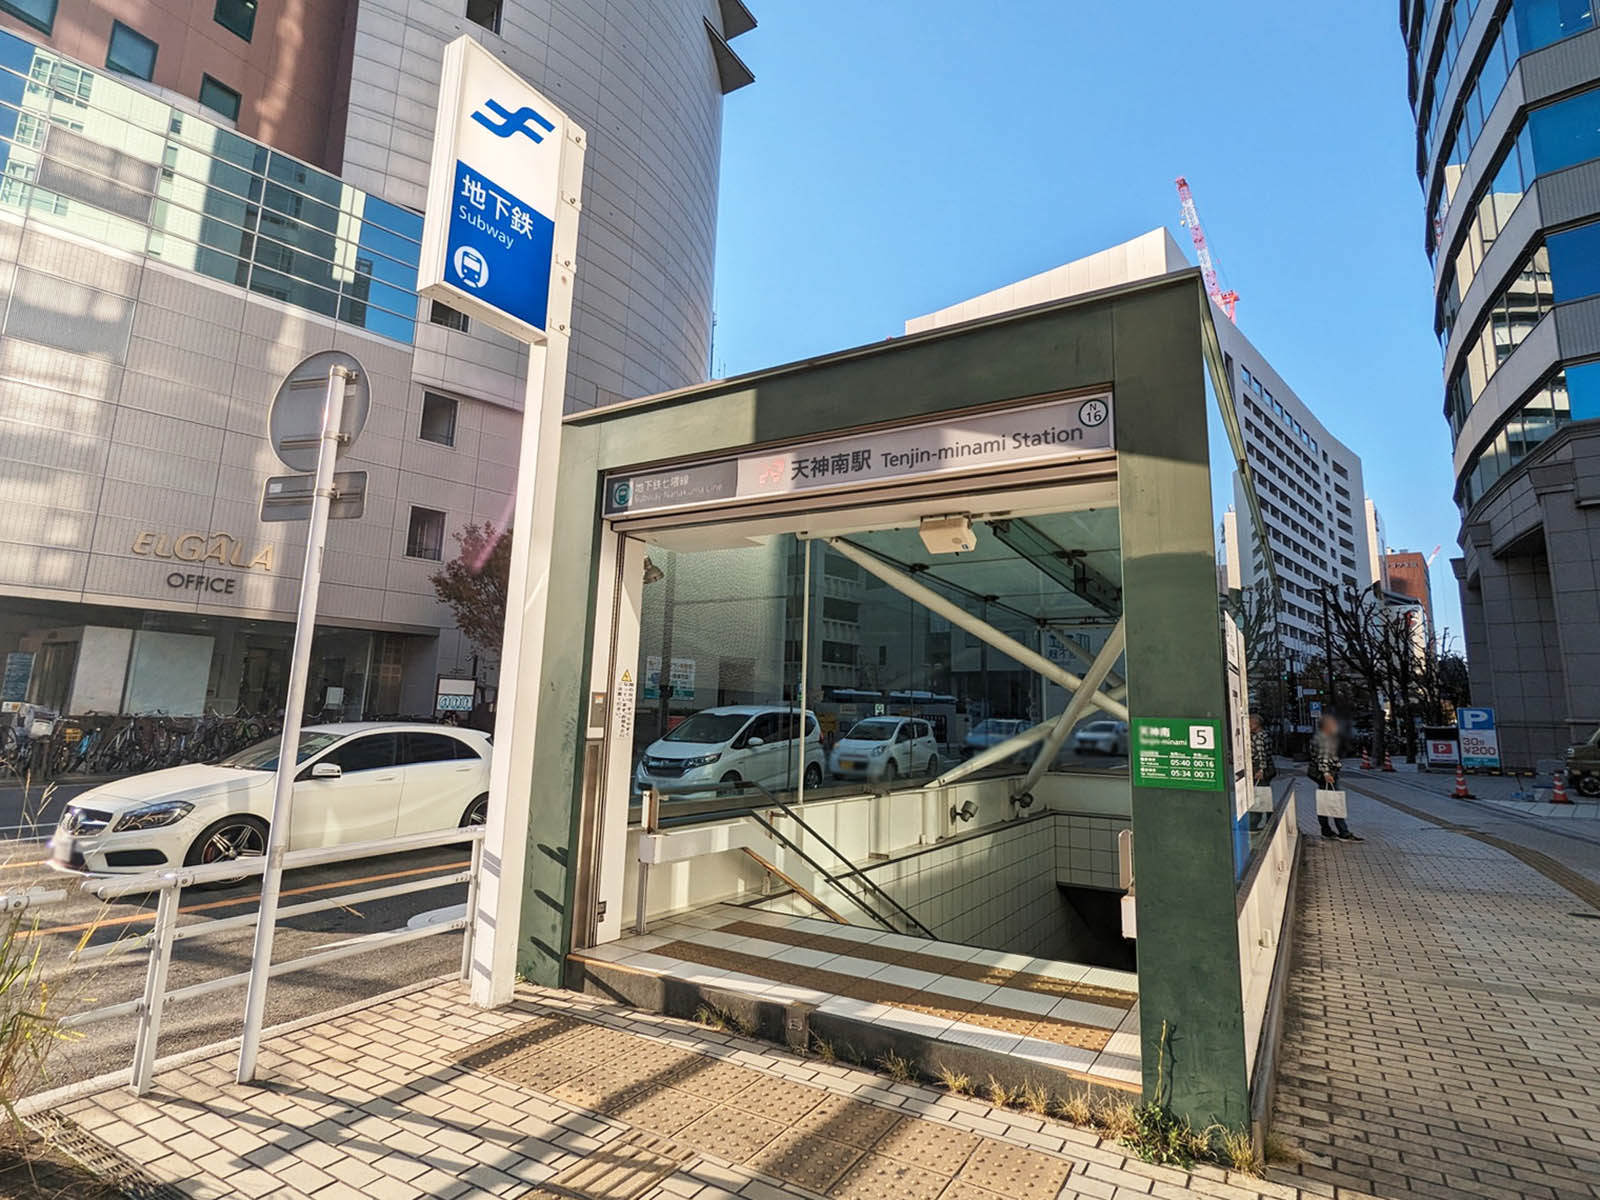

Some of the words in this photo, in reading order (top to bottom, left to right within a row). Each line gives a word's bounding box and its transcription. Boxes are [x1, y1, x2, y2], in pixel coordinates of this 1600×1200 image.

[461, 174, 533, 240] 地下鉄
[459, 204, 514, 250] Subway
[1086, 410, 1102, 423] 16
[1089, 403, 1097, 411] N
[791, 449, 872, 480] 天神南駅
[881, 434, 1006, 469] Tenjin-minami
[1012, 427, 1083, 450] Station
[131, 530, 275, 571] ELGALA
[166, 572, 236, 594] OFFICE
[1463, 710, 1488, 728] P
[1196, 729, 1207, 745] 5
